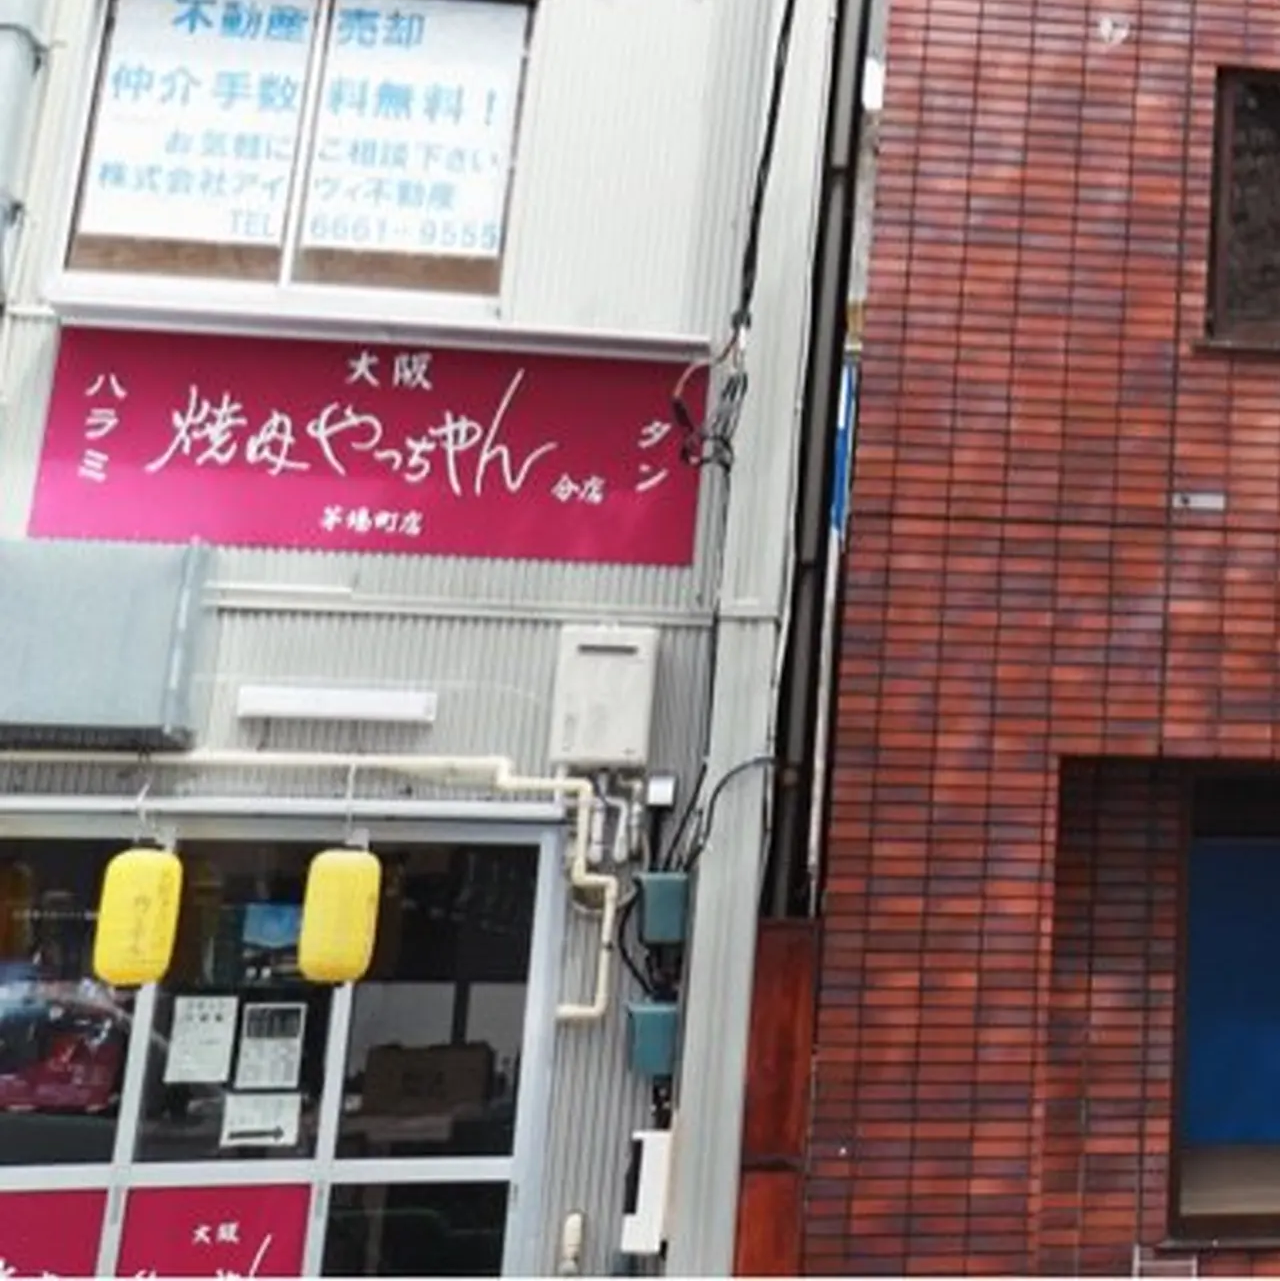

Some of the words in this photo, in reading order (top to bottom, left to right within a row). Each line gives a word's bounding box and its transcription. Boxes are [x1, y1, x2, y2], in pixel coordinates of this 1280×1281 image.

[346, 350, 433, 391] 大阪
[77, 373, 128, 483] ハラミ
[635, 420, 672, 492] タン
